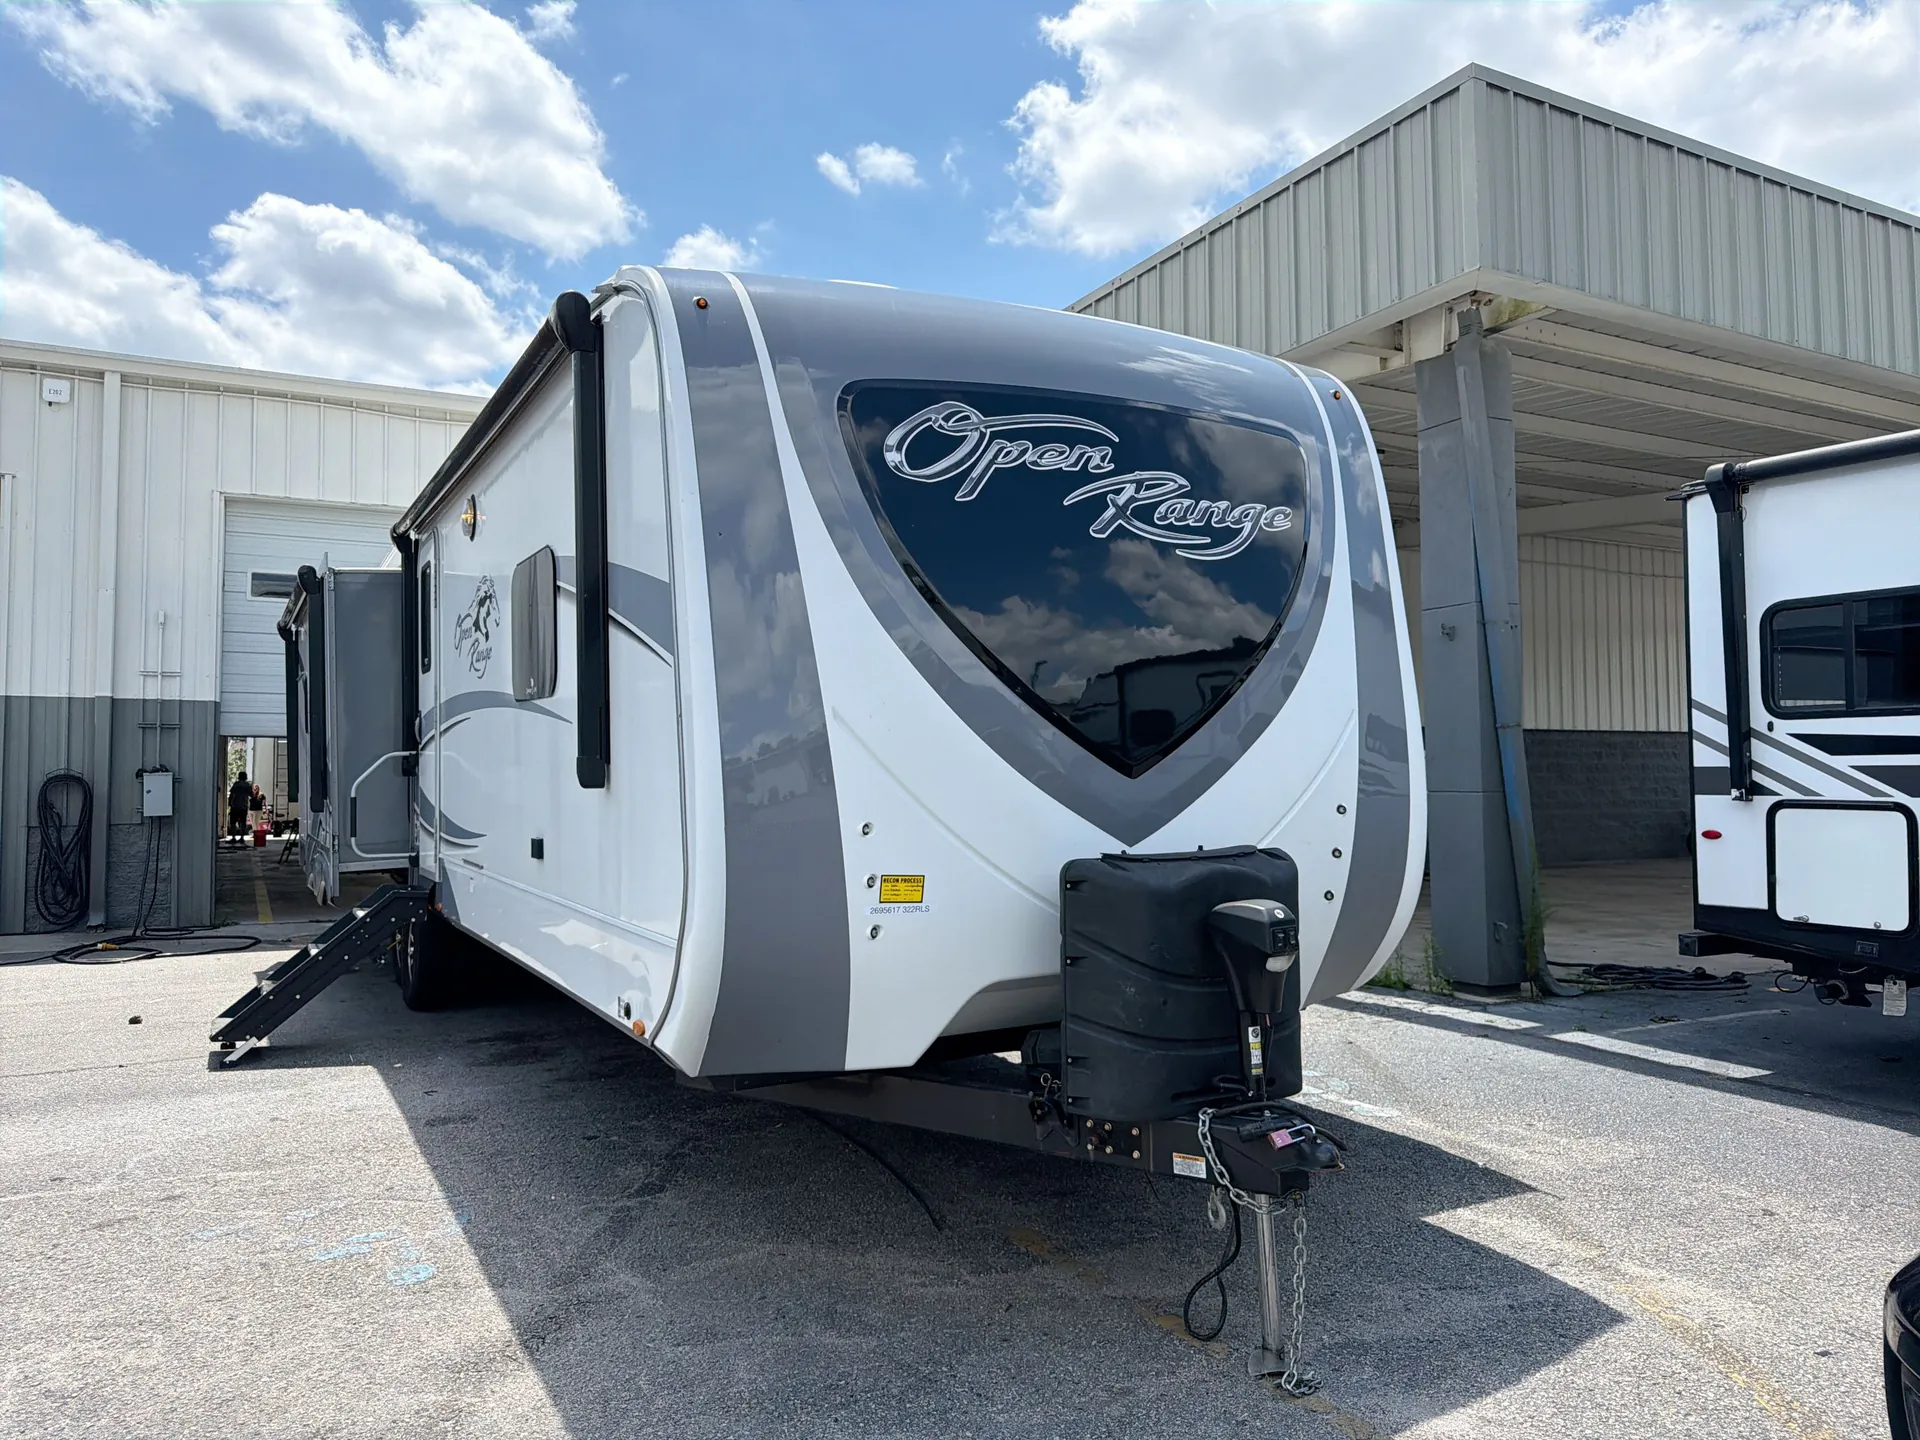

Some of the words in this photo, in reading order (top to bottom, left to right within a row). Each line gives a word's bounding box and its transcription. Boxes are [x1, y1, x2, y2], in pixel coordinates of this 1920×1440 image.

[884, 401, 1119, 501] Open
[1063, 471, 1293, 561] Range
[454, 612, 473, 657] Open
[467, 637, 492, 679] Range
[869, 906, 901, 914] 2695617
[902, 905, 930, 913] 322RLS
